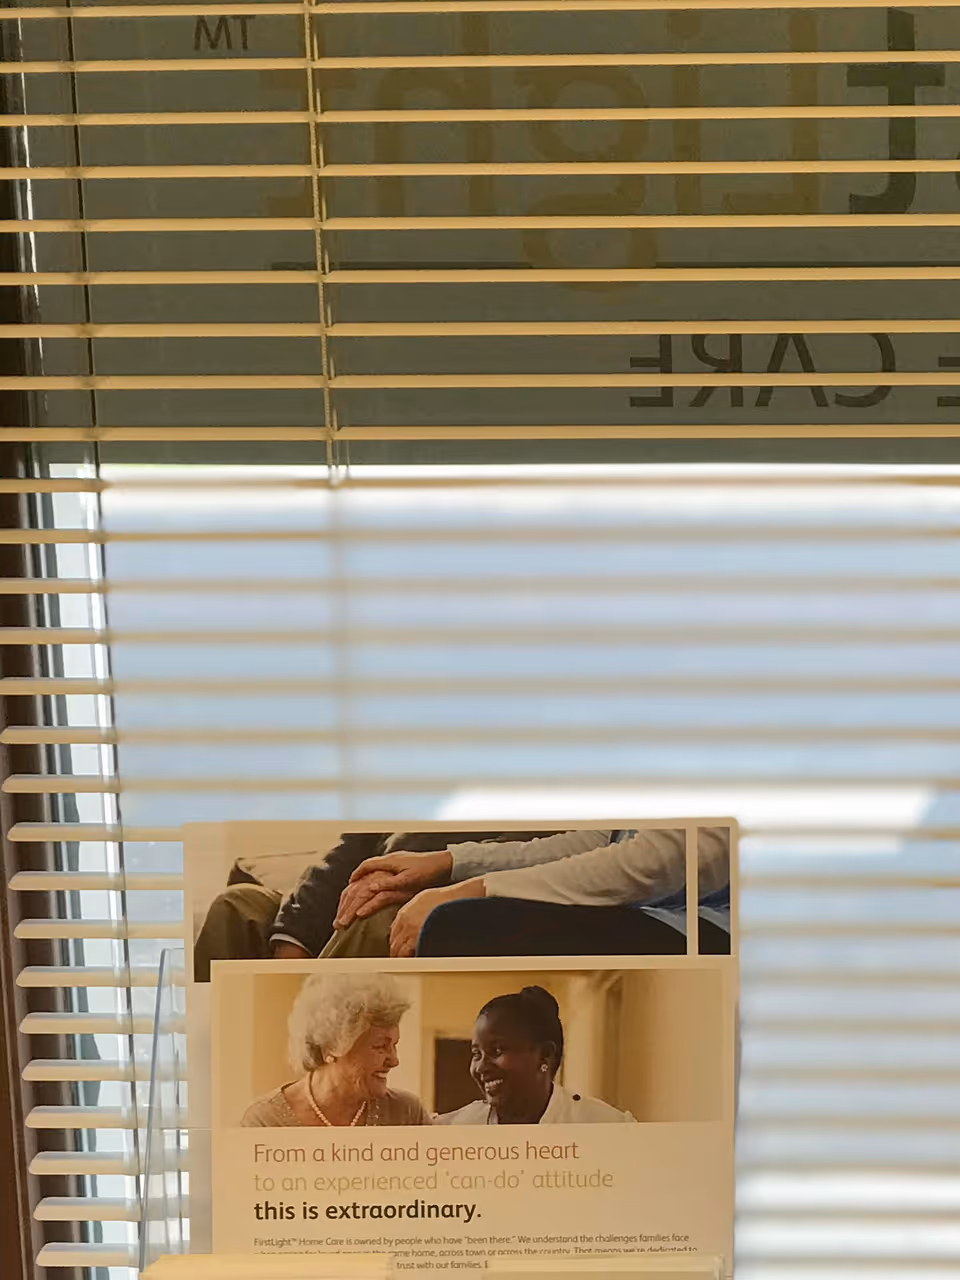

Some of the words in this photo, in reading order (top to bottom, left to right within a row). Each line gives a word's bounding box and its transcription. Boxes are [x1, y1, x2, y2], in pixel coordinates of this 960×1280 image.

[254, 1144, 306, 1162] From
[313, 1148, 325, 1162] a
[332, 1142, 374, 1162] kind
[380, 1142, 419, 1162] and
[426, 1146, 519, 1166] generous
[526, 1140, 580, 1160] heart
[254, 1174, 275, 1191] to
[281, 1177, 307, 1191] an
[314, 1170, 438, 1196] experienced
[446, 1169, 524, 1190] 'can-do'
[532, 1168, 613, 1189] attitude
[254, 1201, 295, 1220] this
[303, 1202, 318, 1220] is
[326, 1199, 481, 1223] extraordinary.
[298, 1238, 324, 1246] Home
[325, 1237, 344, 1246] Care
[354, 1237, 382, 1245] owned
[383, 1237, 394, 1248] by
[394, 1236, 422, 1247] people
[424, 1236, 442, 1244] who
[443, 1236, 463, 1244] have
[464, 1236, 488, 1244] "been
[489, 1236, 516, 1244] there."
[517, 1236, 531, 1244] We
[532, 1234, 579, 1243] understand
[580, 1234, 594, 1244] the
[595, 1233, 638, 1244] challenges
[639, 1233, 670, 1242] families
[672, 1233, 689, 1242] face
